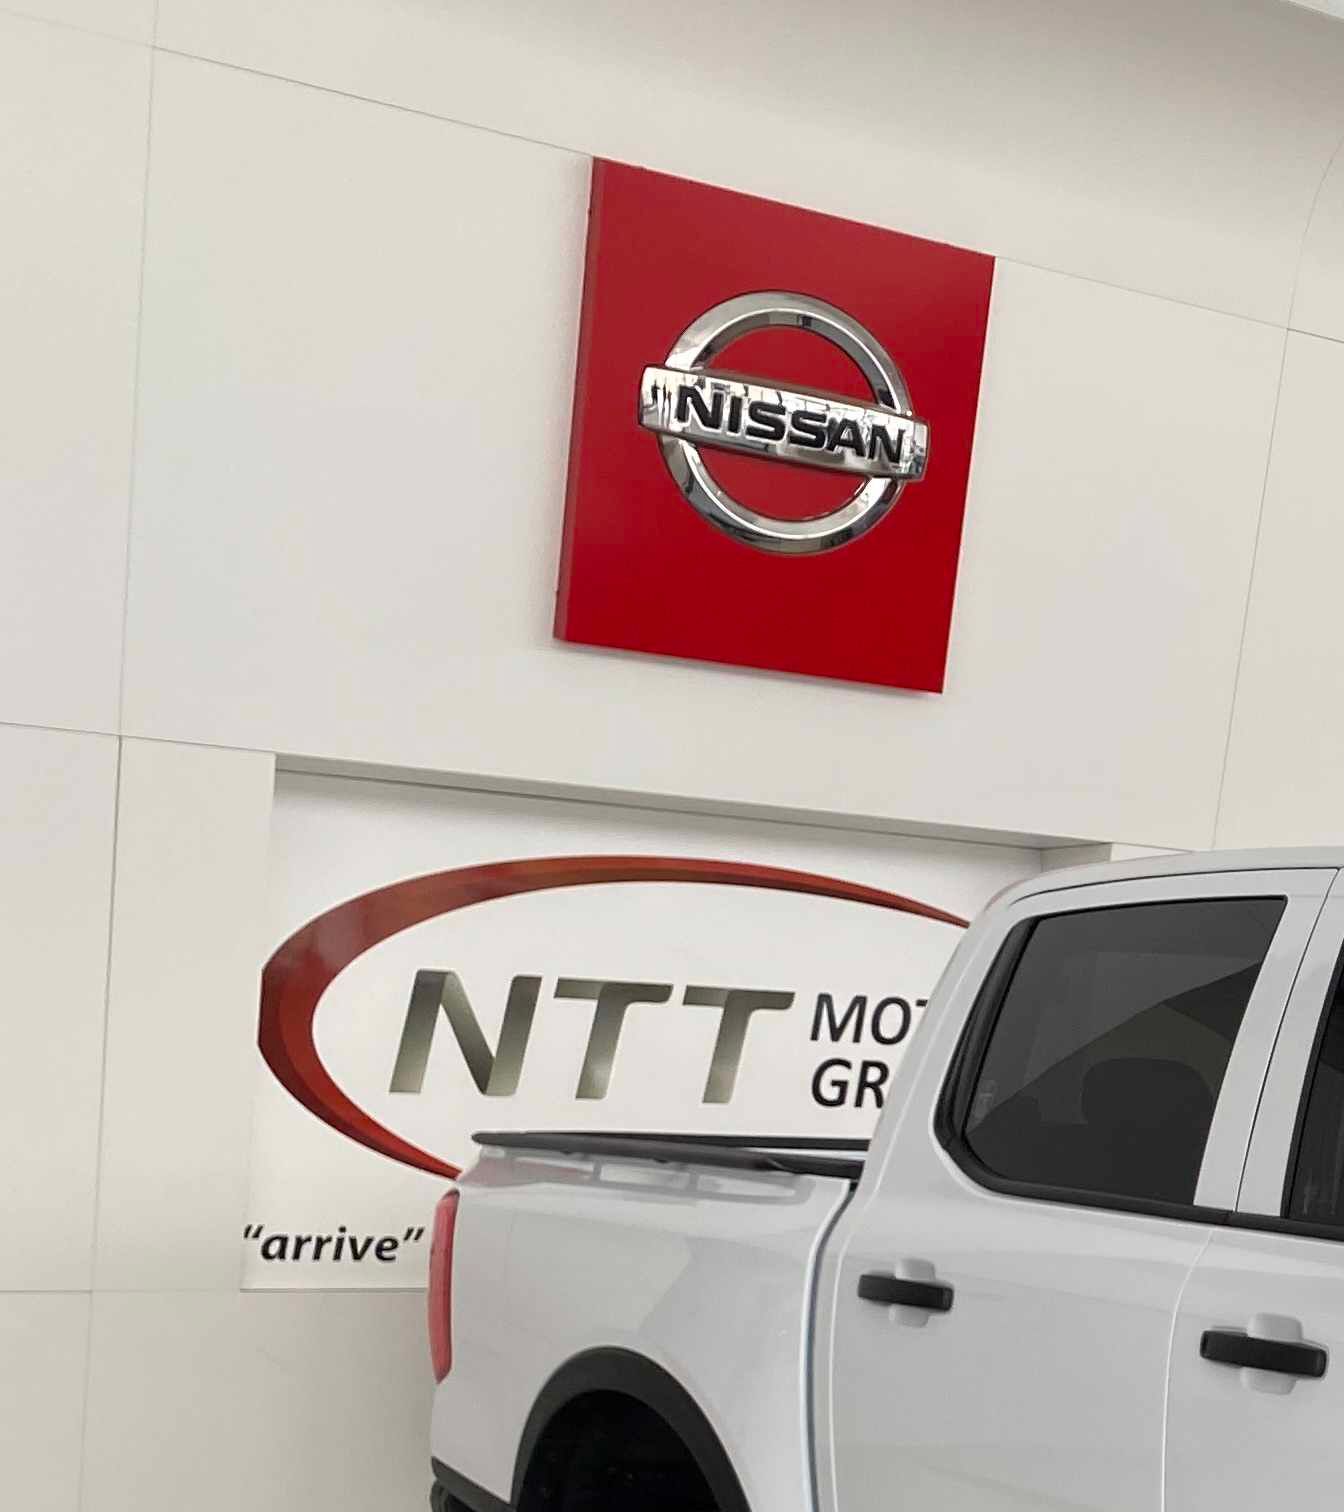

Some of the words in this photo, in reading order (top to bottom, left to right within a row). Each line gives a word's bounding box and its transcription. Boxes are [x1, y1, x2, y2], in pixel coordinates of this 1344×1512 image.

[675, 383, 906, 464] NISSAN
[389, 968, 796, 1105] NTT
[810, 992, 928, 1045] MO
